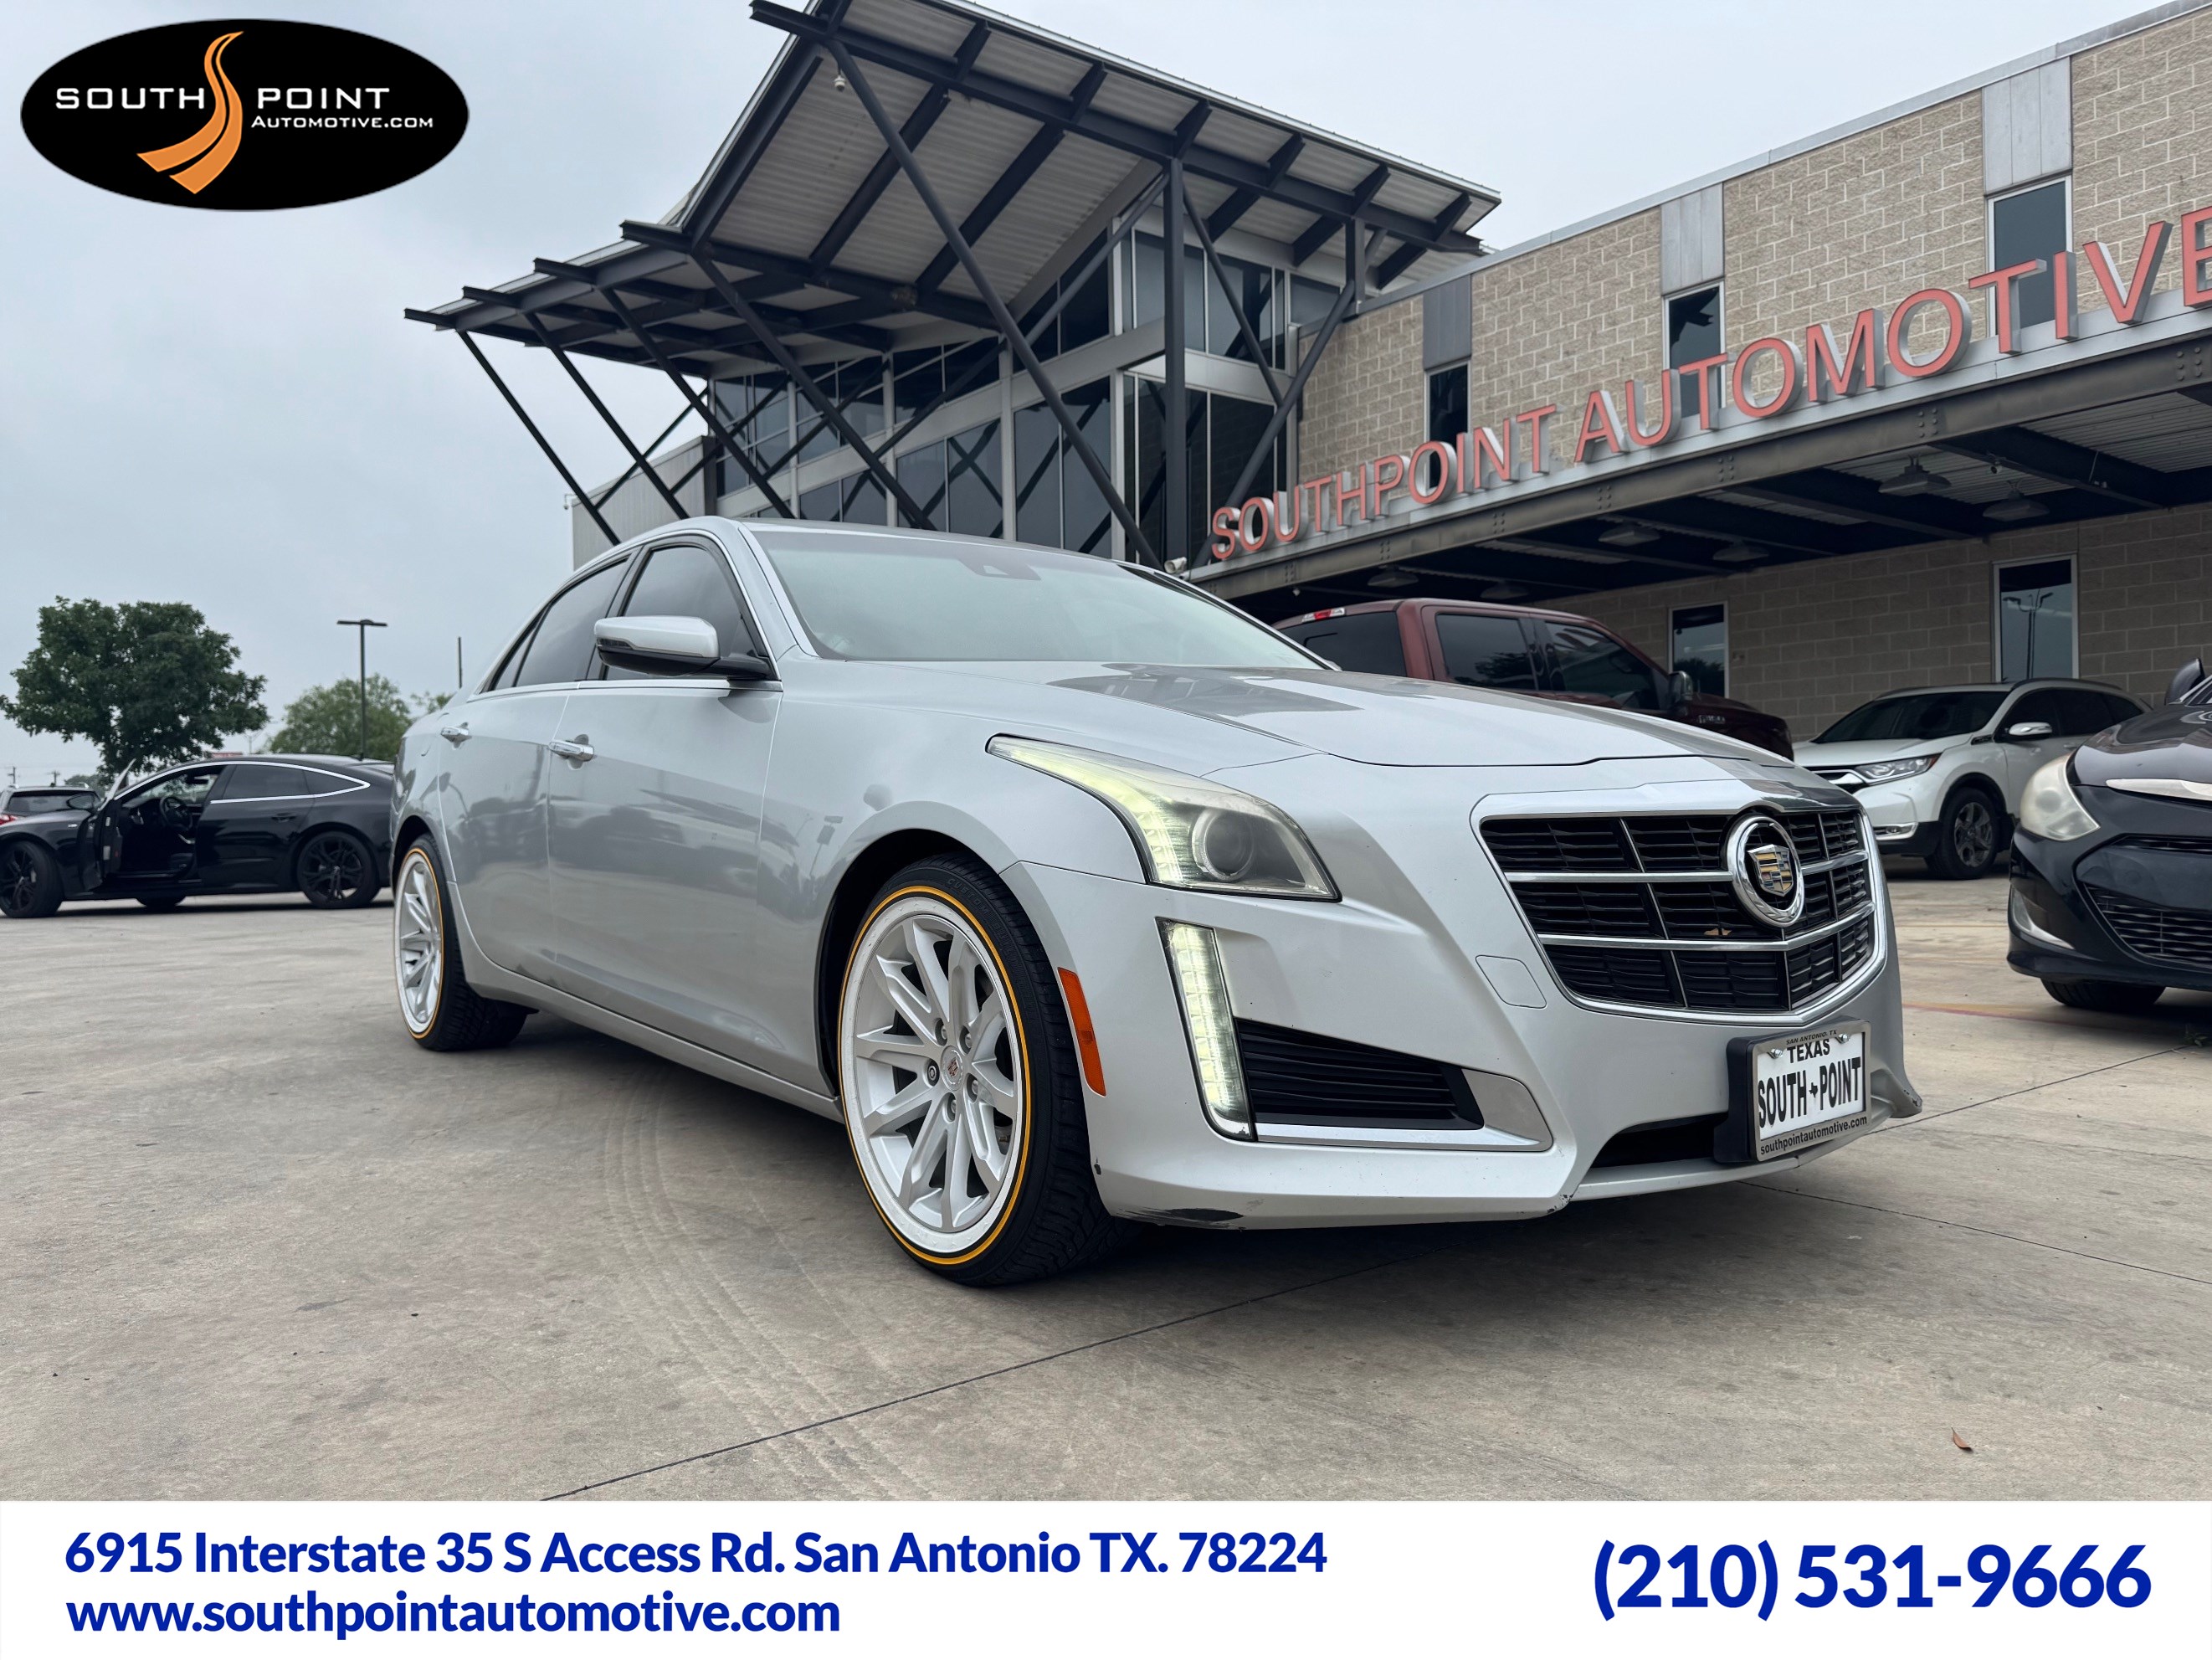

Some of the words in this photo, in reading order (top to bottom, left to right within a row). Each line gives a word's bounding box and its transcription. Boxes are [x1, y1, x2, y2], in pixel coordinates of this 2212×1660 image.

[1212, 403, 1560, 560] SOUTHPOINT
[1574, 206, 2212, 463] AUTOMOTIVE
[1787, 1038, 1830, 1064] TEXAS
[1758, 1070, 1807, 1128] SOUTH
[1819, 1056, 1861, 1111] POINT
[1760, 1115, 1868, 1155] southpointautomotive.com
